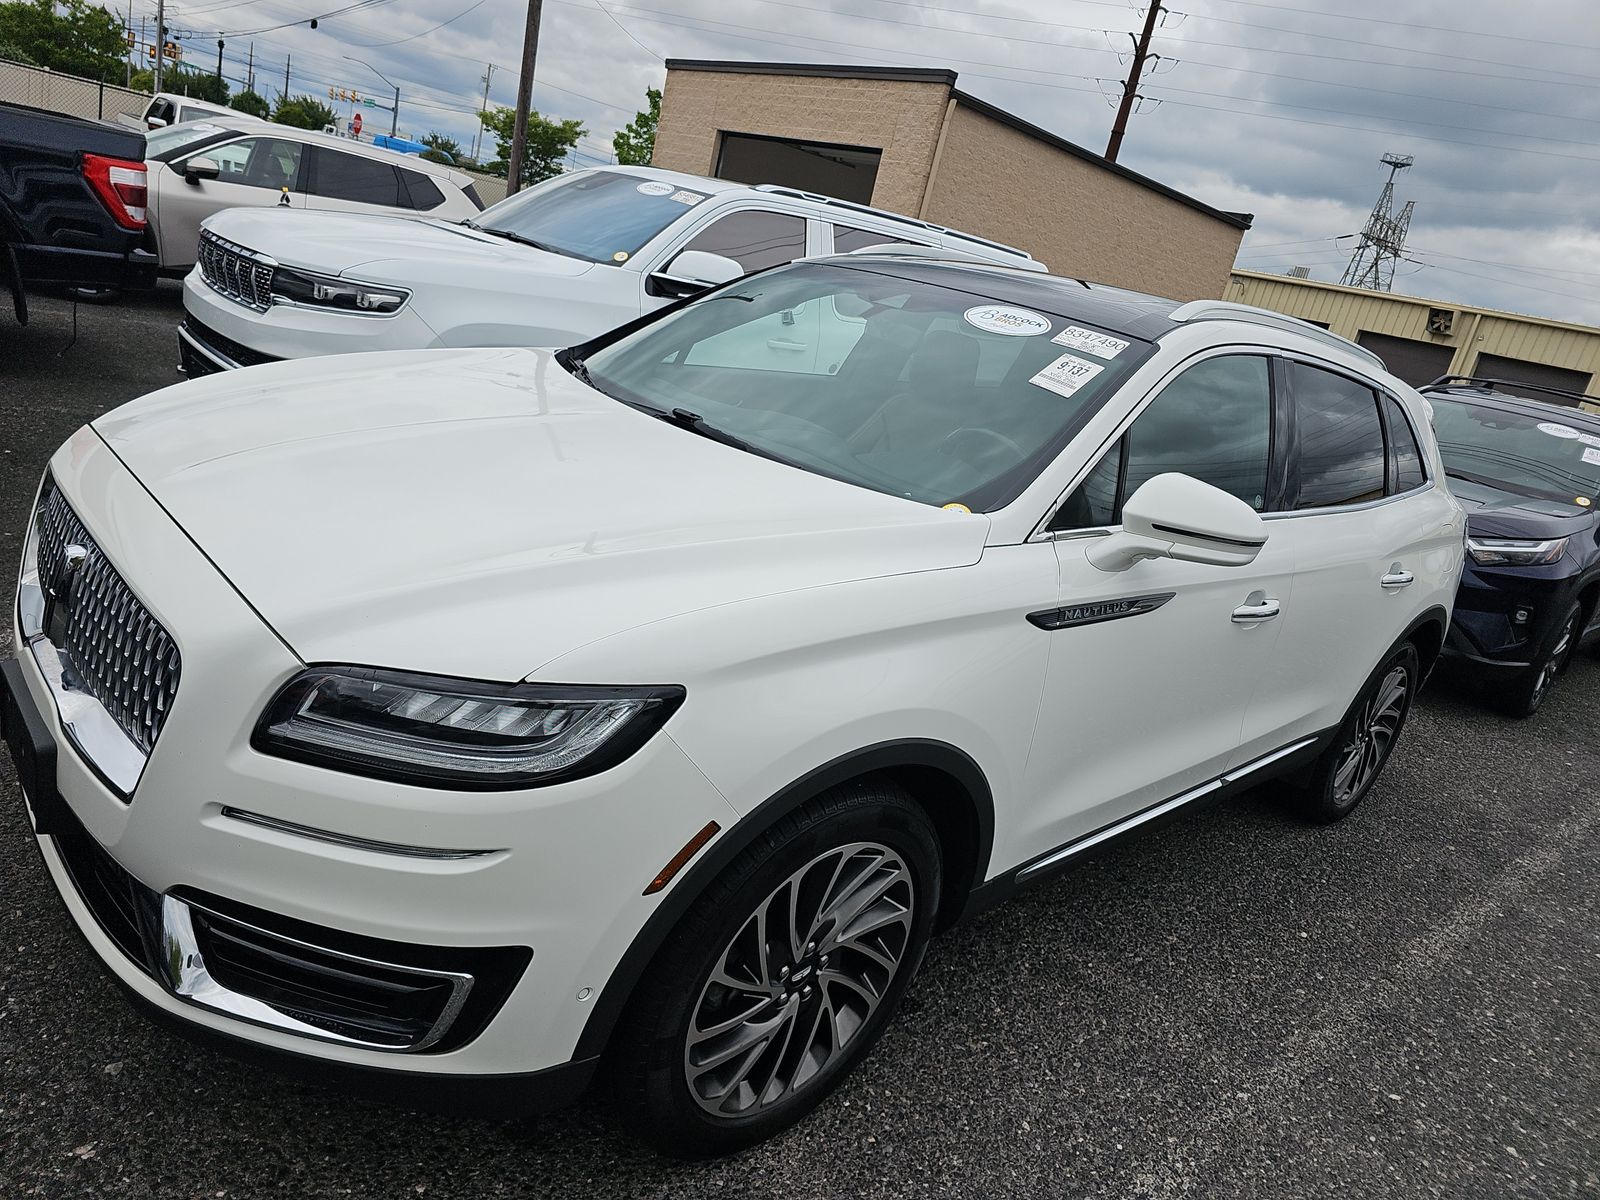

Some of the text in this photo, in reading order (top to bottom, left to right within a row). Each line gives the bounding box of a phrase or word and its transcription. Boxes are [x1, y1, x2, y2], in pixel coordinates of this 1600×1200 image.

[994, 316, 1023, 328] BROS
[1000, 313, 1044, 328] ADCOCK
[1064, 328, 1126, 351] 8347490
[1064, 602, 1129, 620] NAUTILUS
